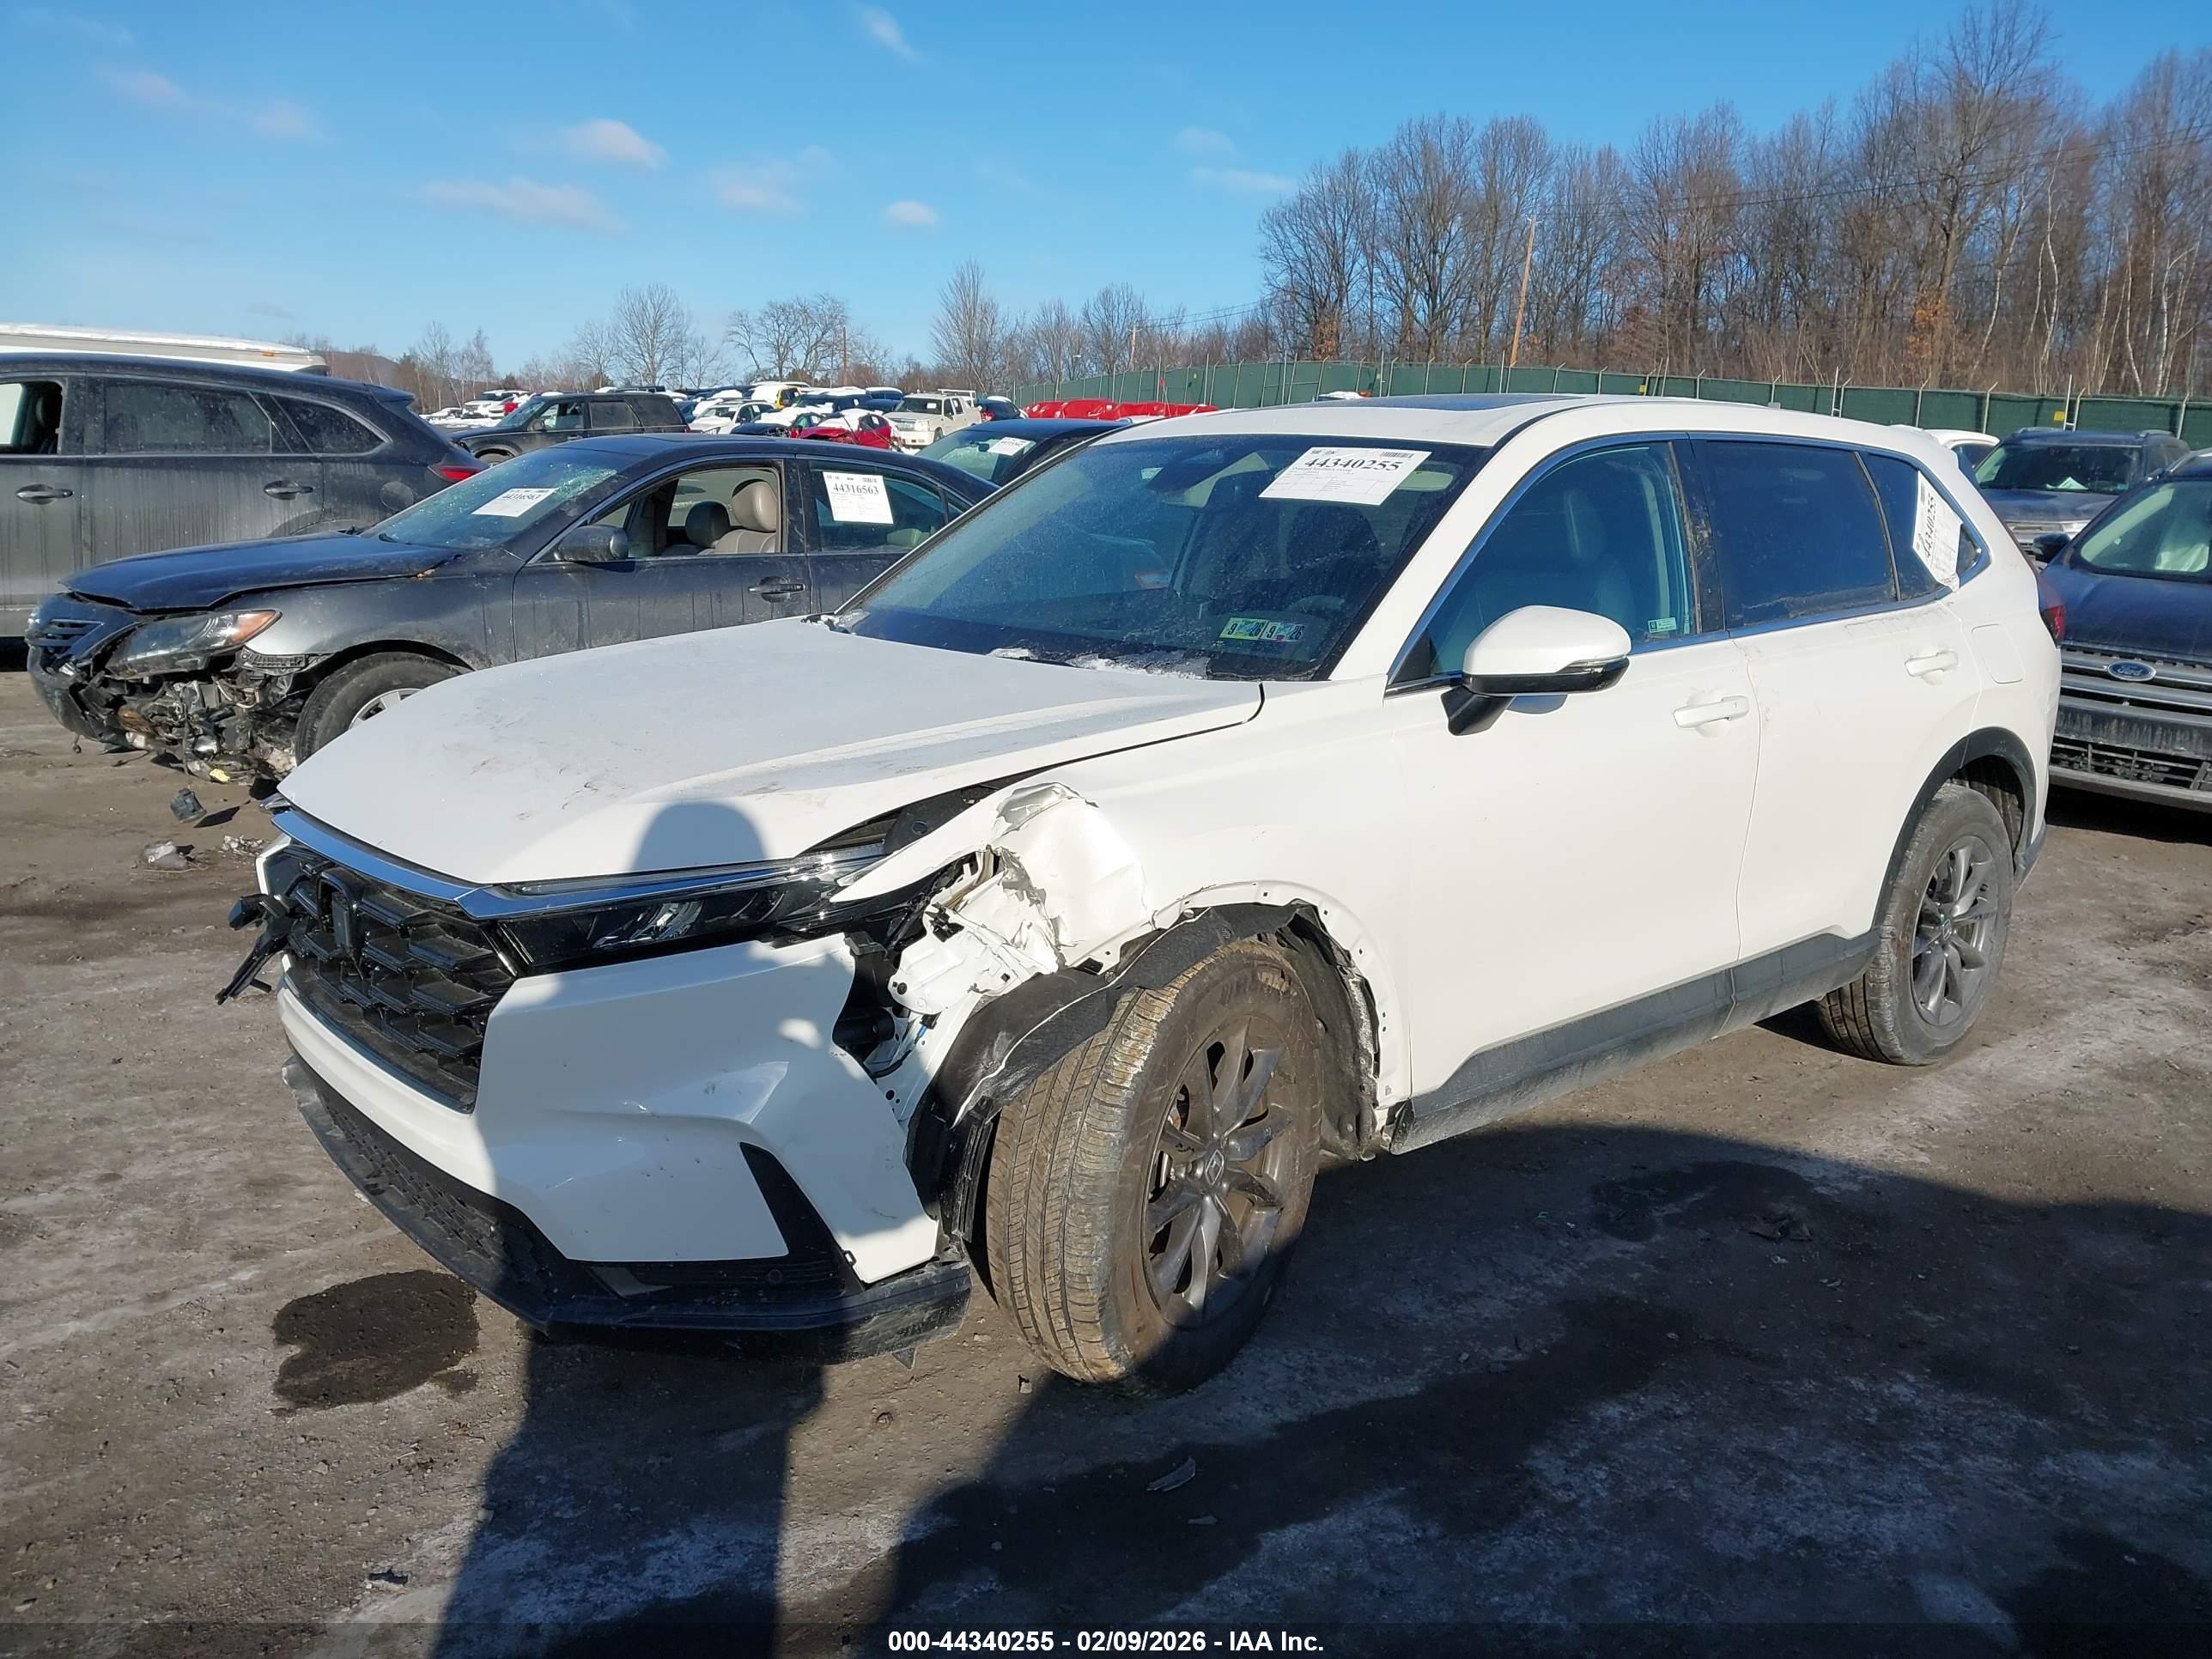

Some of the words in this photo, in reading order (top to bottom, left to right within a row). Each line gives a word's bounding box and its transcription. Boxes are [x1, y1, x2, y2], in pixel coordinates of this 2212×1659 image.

[1304, 457, 1405, 471] 44340255
[1227, 623, 1238, 635] 9
[2117, 664, 2143, 676] Ford
